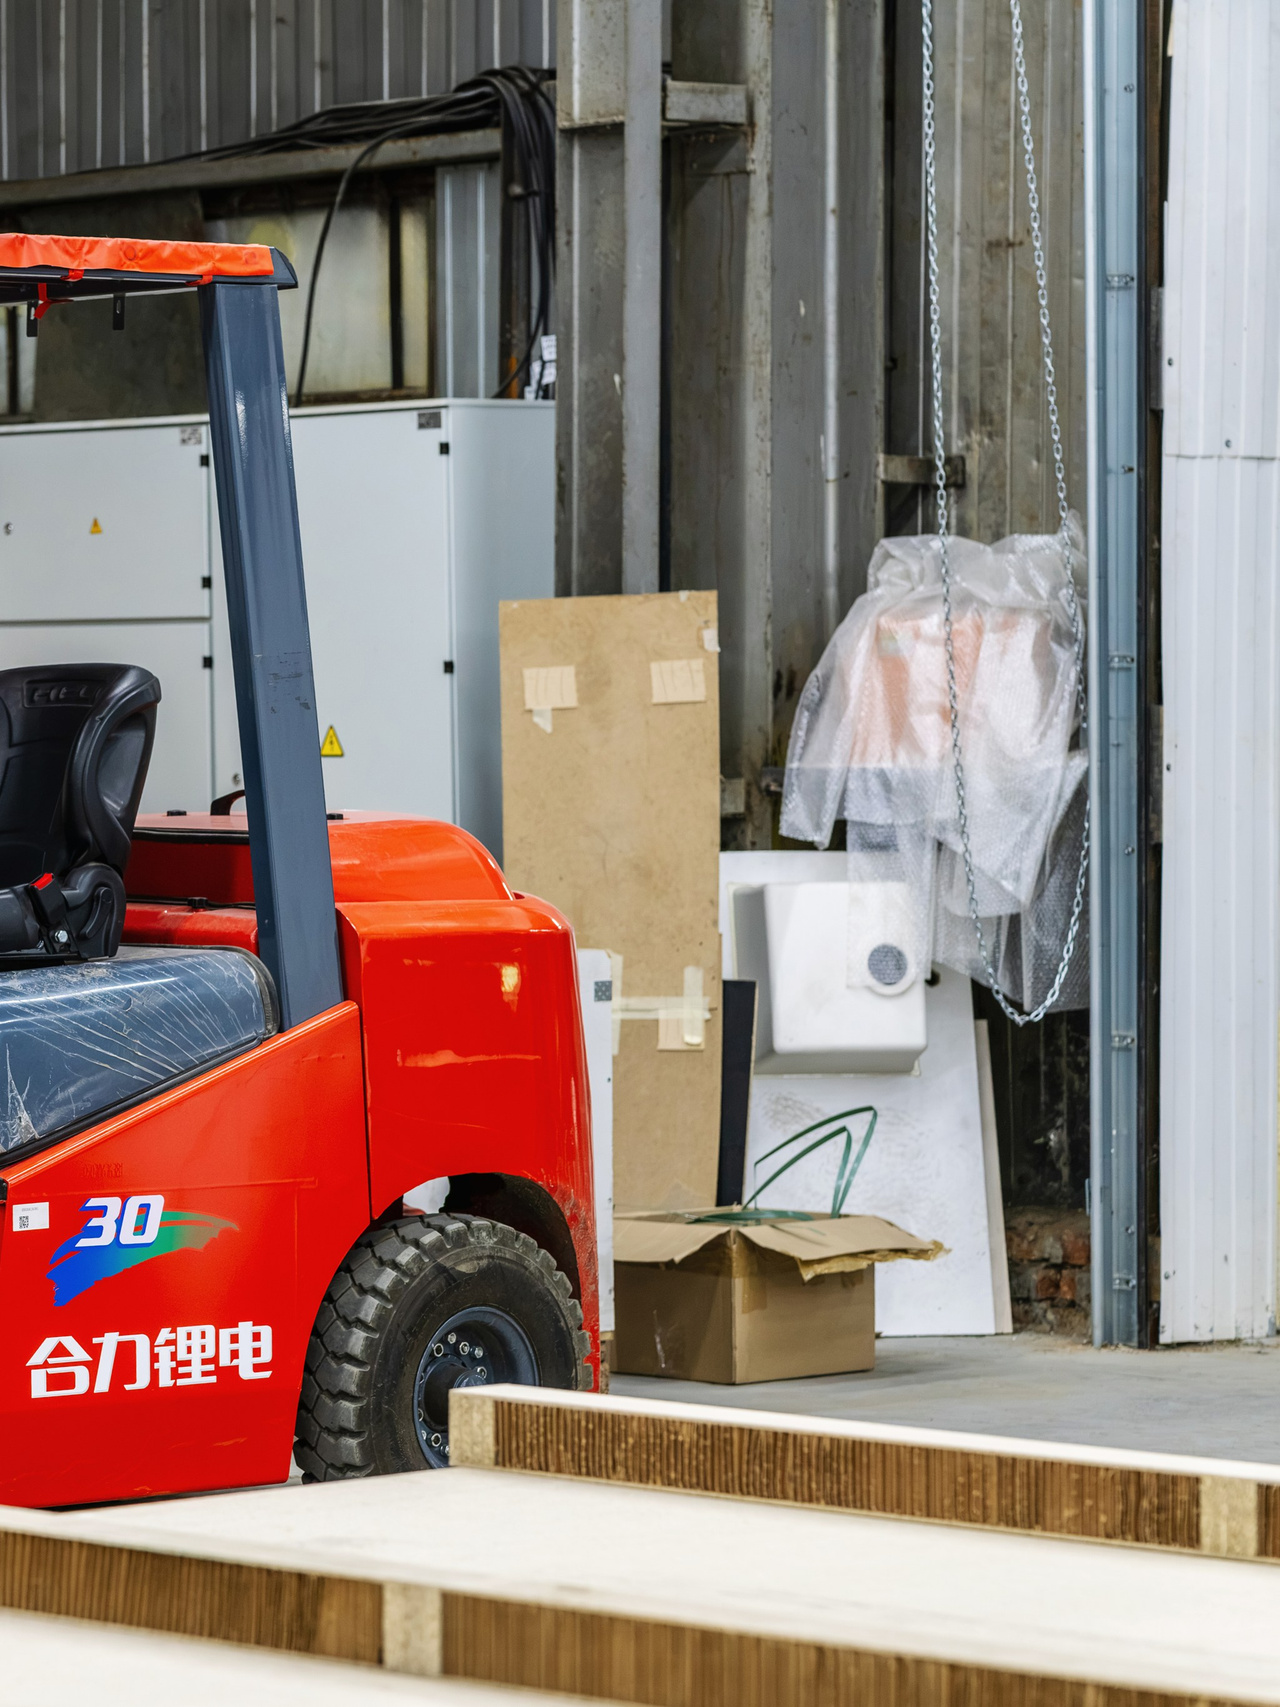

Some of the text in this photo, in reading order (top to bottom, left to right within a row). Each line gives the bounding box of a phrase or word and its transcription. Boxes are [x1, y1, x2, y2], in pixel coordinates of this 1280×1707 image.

[75, 1195, 165, 1248] 30
[25, 1321, 273, 1399] 合力锂电
